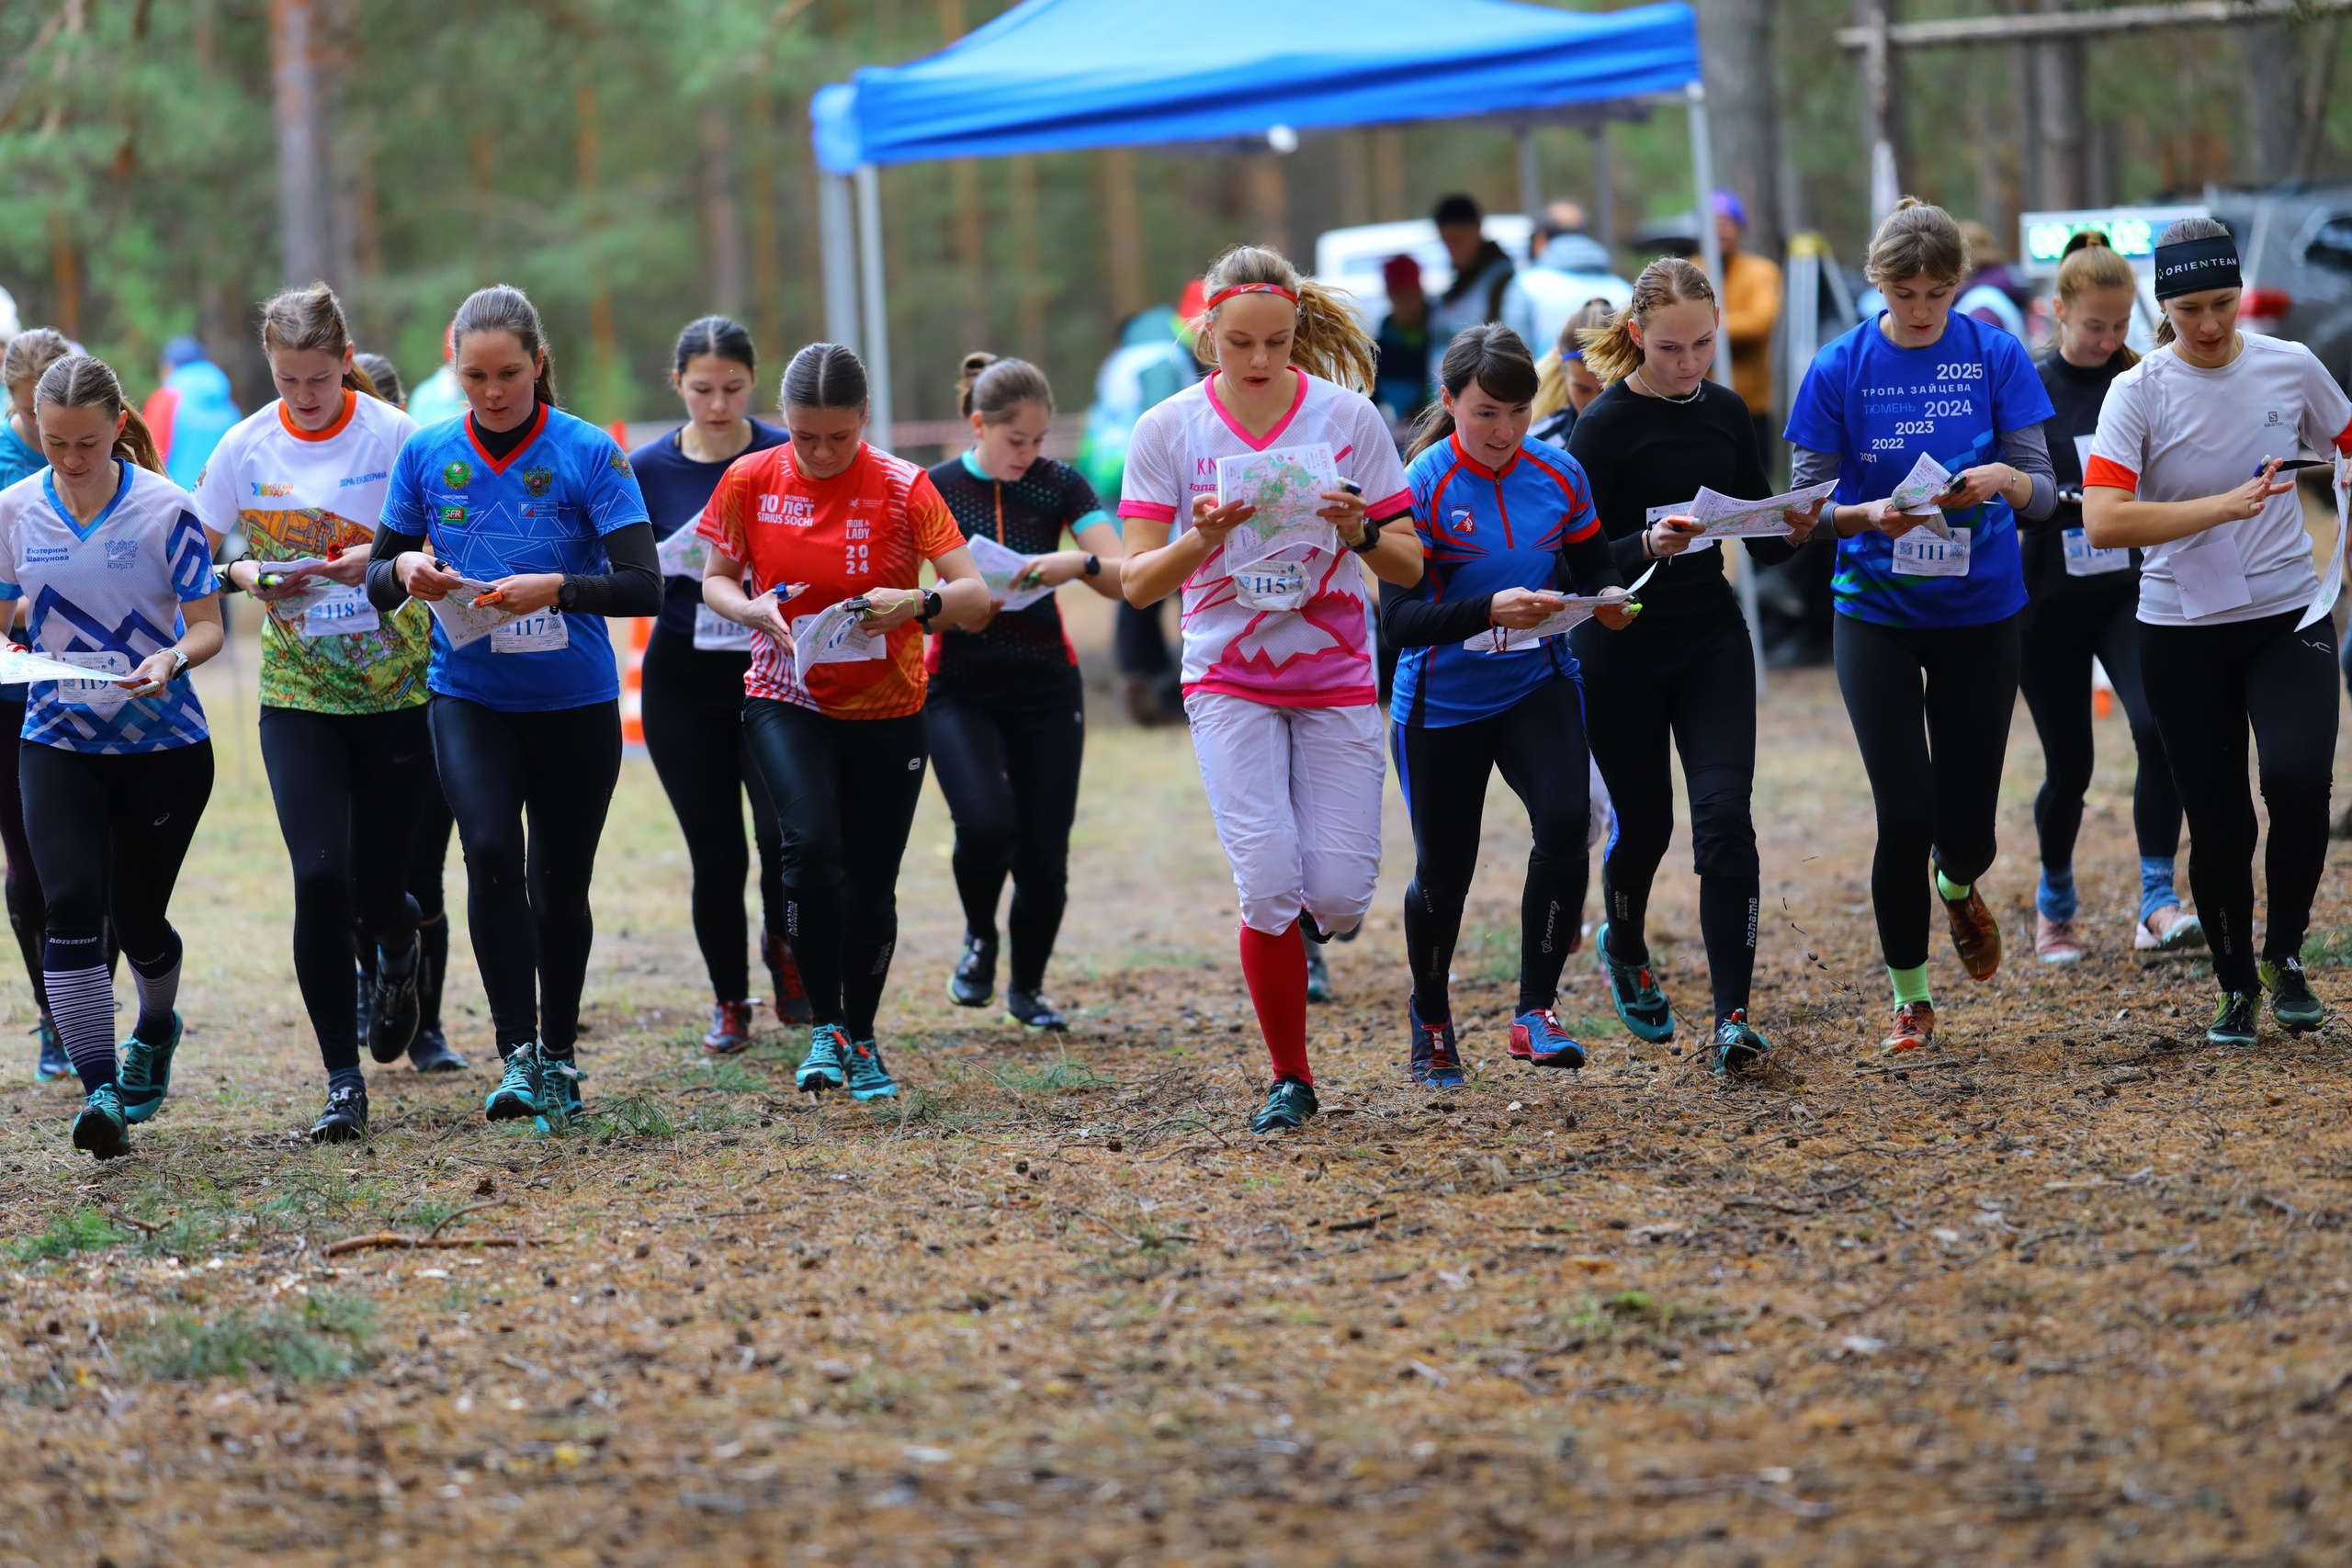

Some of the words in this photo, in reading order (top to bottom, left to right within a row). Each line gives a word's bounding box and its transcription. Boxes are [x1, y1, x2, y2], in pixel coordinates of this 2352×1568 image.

[2165, 257, 2237, 276] ORIENTEAM
[1936, 363, 1984, 380] 2025
[1861, 387, 1905, 397] ТРОПА
[1910, 383, 1972, 394] ЗАЙЦЕВА
[1863, 402, 1917, 414] ТЮМЕНЬ
[1924, 400, 1973, 418] 2024
[1894, 421, 1935, 435] 2023
[1871, 438, 1905, 450] 2022
[1860, 452, 1877, 463] 2021
[340, 478, 356, 487] ДОЧЬ
[356, 471, 388, 485] ЕКАТЕРИНА
[759, 494, 779, 513] 10
[781, 501, 815, 517] лет
[757, 512, 783, 524] SIRIUS
[785, 515, 813, 527] SOCHI
[846, 519, 864, 528] IRON
[846, 528, 870, 539] LADY
[27, 547, 68, 556] Екатерина
[846, 545, 869, 558] 20
[1917, 544, 1944, 560] 111
[26, 555, 70, 563] Шавкунова
[846, 560, 869, 574] 24
[1255, 577, 1286, 593] 115
[326, 602, 356, 619] 118
[515, 617, 546, 636] 117
[1746, 897, 1758, 947] noname
